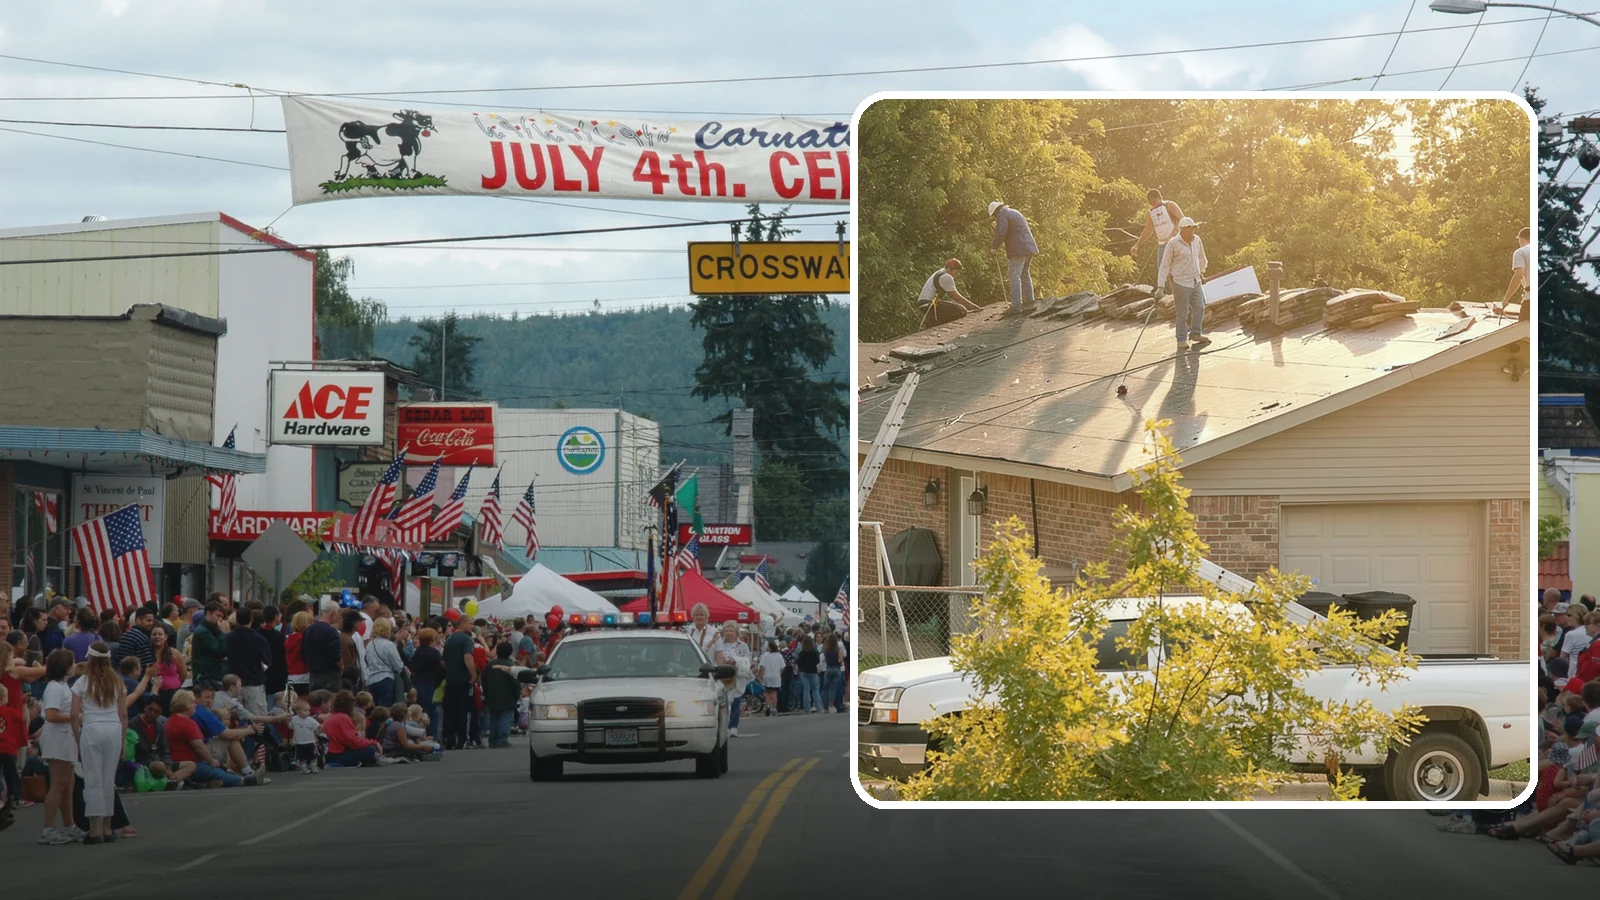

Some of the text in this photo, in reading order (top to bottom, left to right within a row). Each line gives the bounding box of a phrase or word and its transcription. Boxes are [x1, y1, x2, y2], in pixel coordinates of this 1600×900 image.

[481, 140, 605, 192] JULY
[632, 149, 746, 198] 4th.
[696, 254, 850, 280] CROSSWA
[282, 379, 374, 420] ACE
[406, 409, 452, 422] CEDAR
[283, 420, 371, 437] Hardware
[416, 428, 477, 447] Coca-Cola
[353, 467, 385, 480] Simpl
[95, 485, 124, 495] Vincent
[126, 485, 136, 495] de
[137, 486, 155, 495] Paul
[80, 503, 154, 522] THT
[212, 516, 331, 536] HARDARE
[687, 526, 741, 535] CRNATION
[699, 535, 730, 543] GLASS
